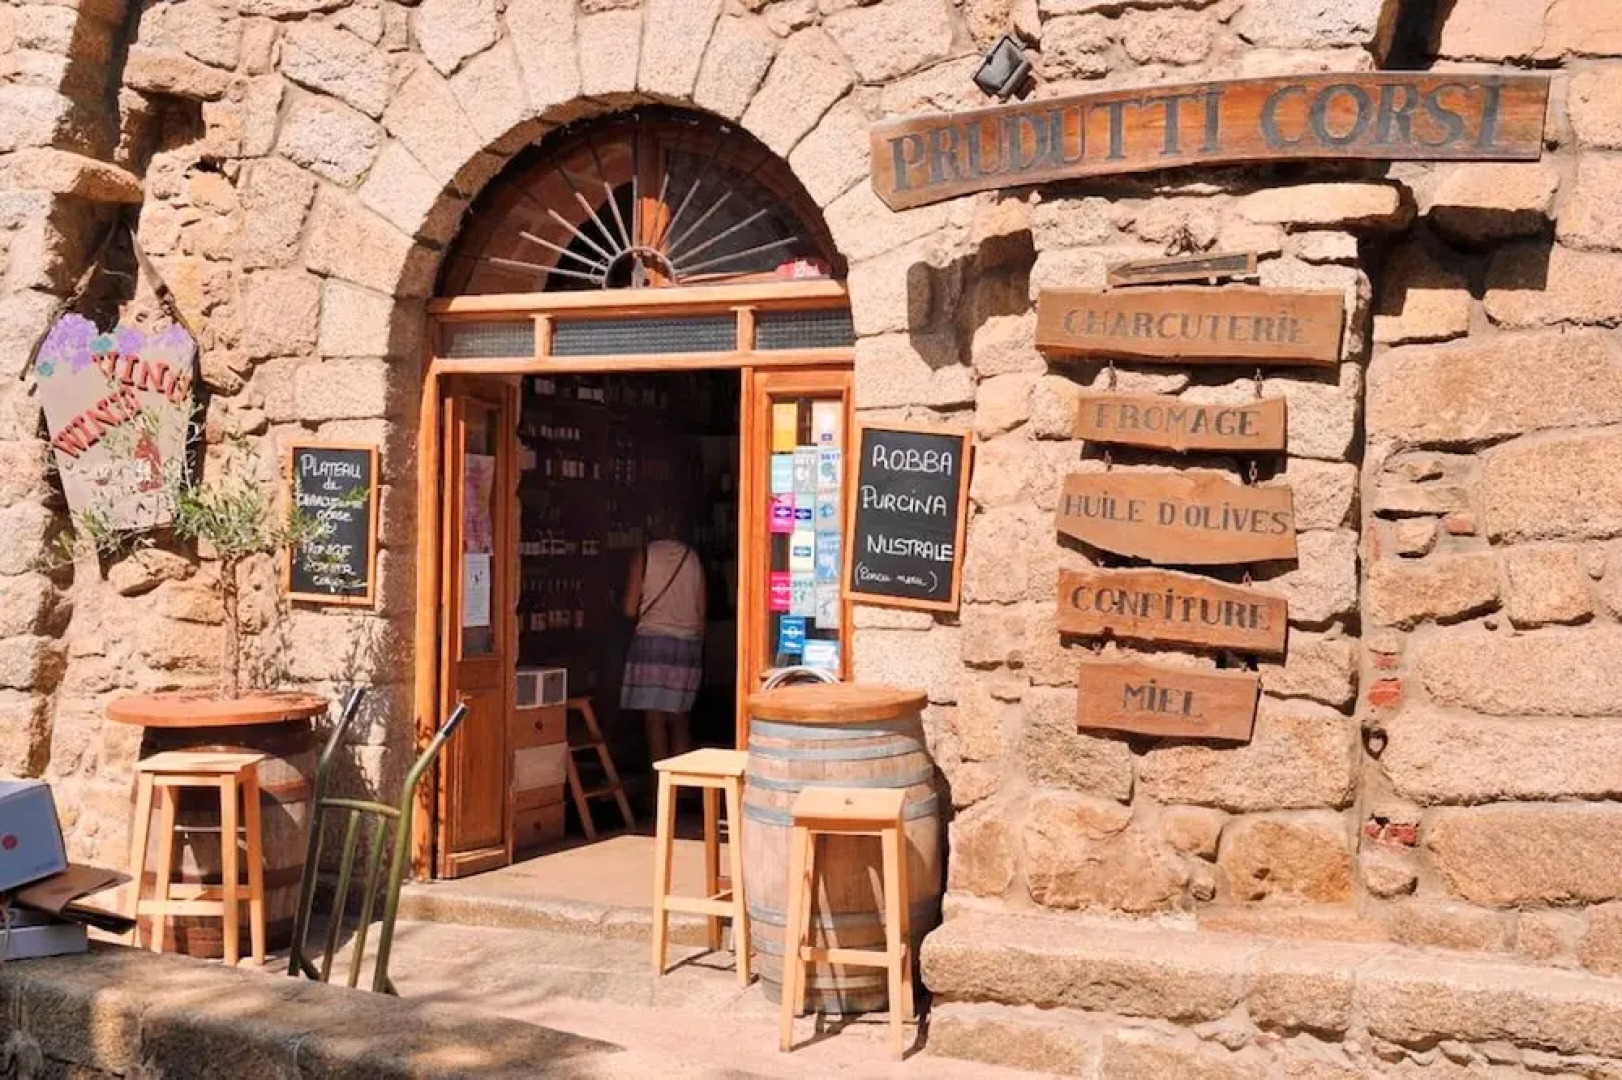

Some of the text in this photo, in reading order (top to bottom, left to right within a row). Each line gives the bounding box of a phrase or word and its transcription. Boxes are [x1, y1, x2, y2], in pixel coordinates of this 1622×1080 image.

[888, 75, 1507, 193] PRUDUTTI CORSI
[1094, 402, 1262, 438] FROMAGE
[872, 444, 953, 475] ROBBA
[1064, 490, 1146, 523] HUILE
[867, 534, 954, 562] NUSTRALE
[1071, 586, 1272, 632] CONFITURE
[1122, 678, 1203, 717] MIEL
